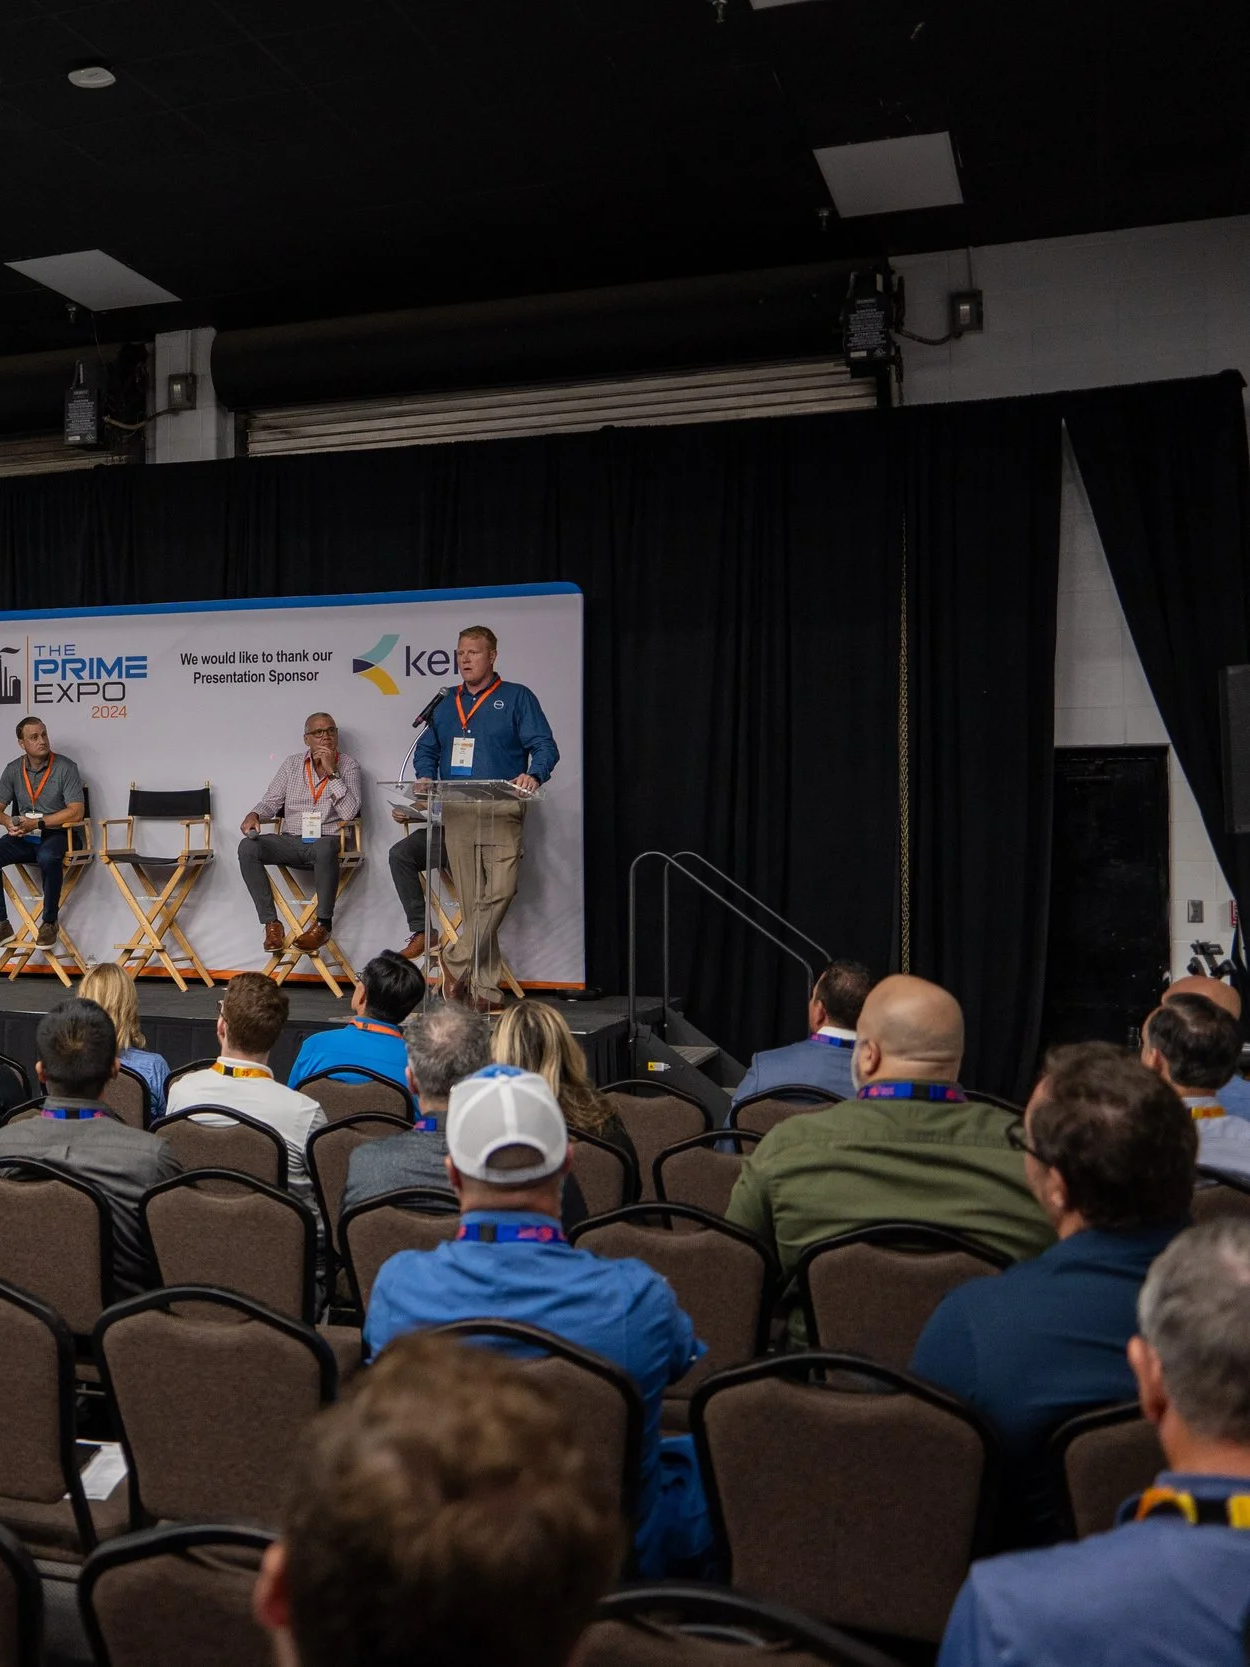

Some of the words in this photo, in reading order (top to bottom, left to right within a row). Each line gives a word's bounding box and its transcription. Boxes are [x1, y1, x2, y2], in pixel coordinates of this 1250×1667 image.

[34, 644, 76, 656] THE
[180, 653, 198, 665] We
[201, 652, 236, 665] would
[239, 651, 259, 664] like
[262, 651, 273, 663] to
[276, 650, 309, 663] thank
[312, 651, 333, 661] our
[34, 656, 148, 681] PRIME
[406, 646, 458, 676] ke
[193, 670, 265, 684] Presentation
[268, 669, 319, 685] Sponsor
[34, 682, 126, 704] EXPO
[91, 705, 128, 719] 2024
